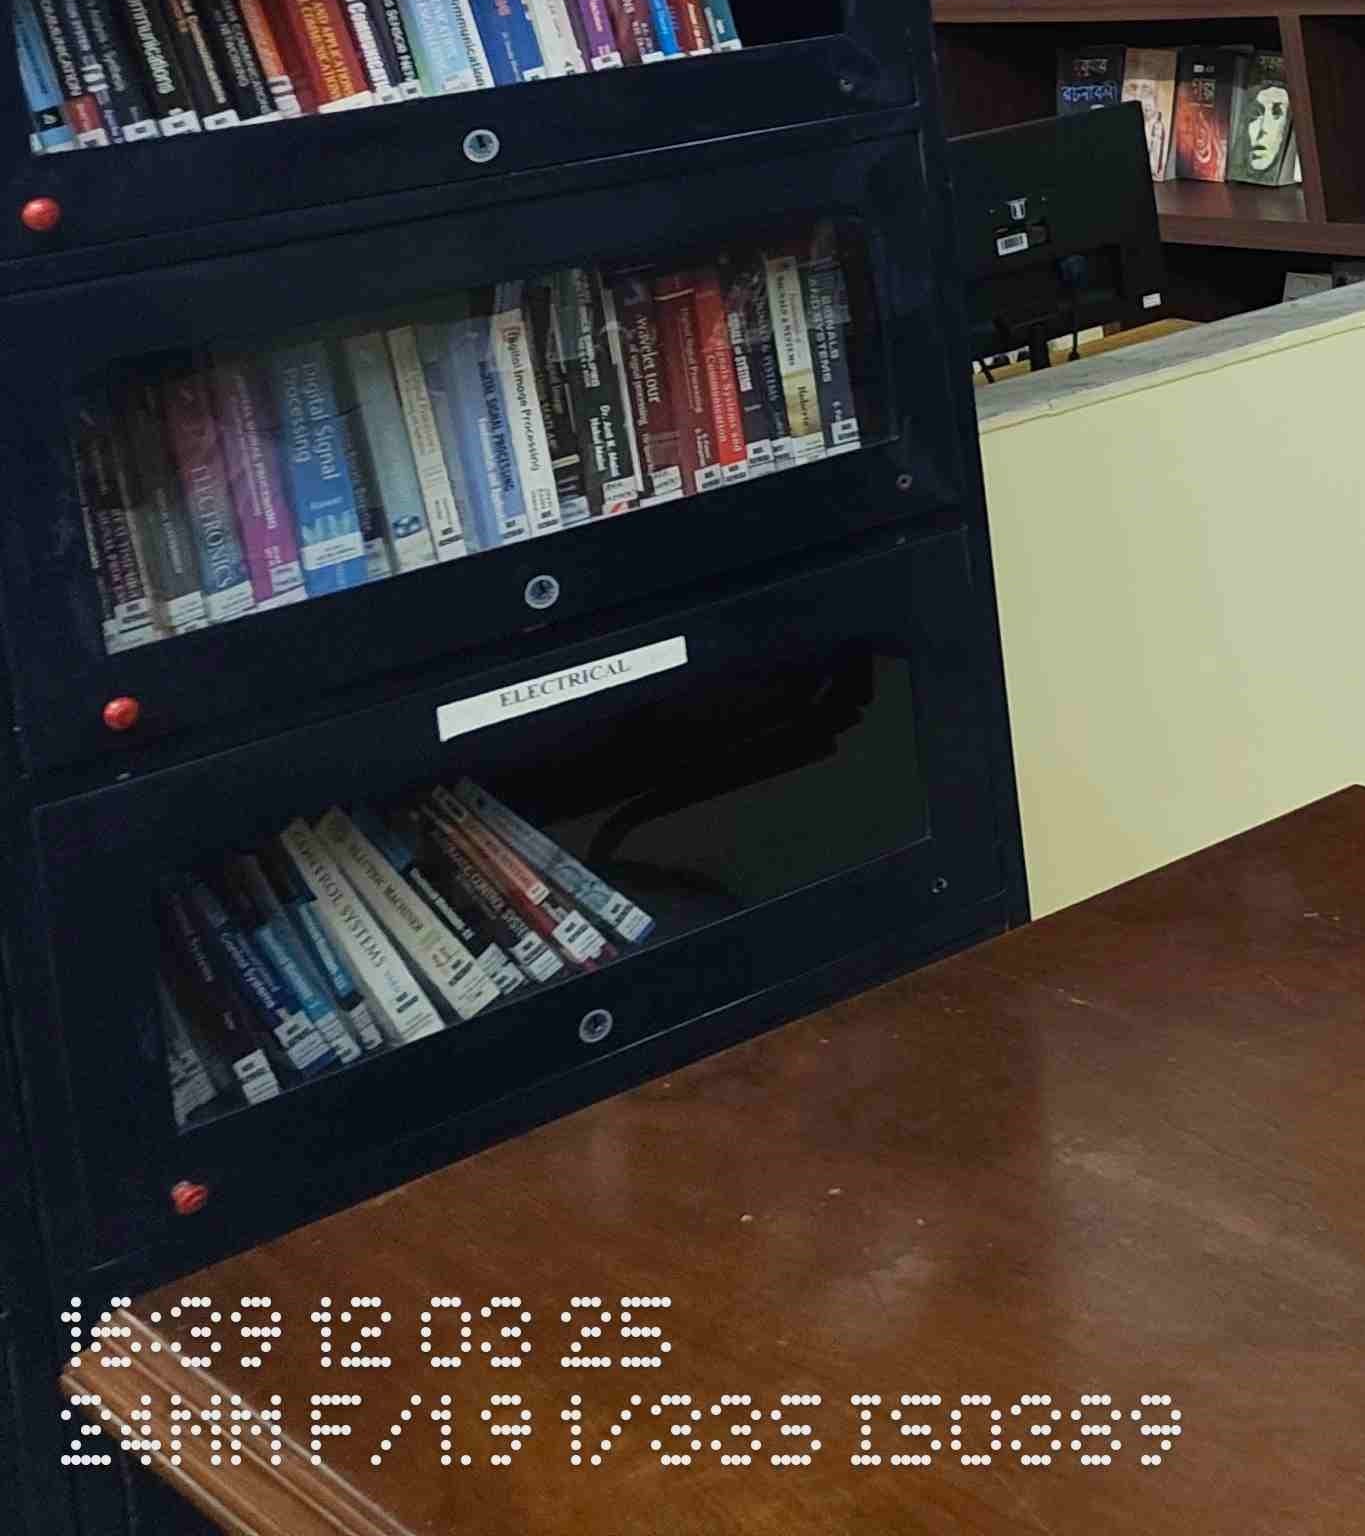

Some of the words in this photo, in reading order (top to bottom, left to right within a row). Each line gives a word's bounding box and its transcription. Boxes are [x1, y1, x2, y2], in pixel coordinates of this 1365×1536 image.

[347, 0, 391, 92] COMMUNICATI
[276, 366, 316, 465] Processing
[295, 359, 331, 422] Digital
[510, 369, 530, 407] Image
[642, 372, 664, 404] tour
[309, 423, 343, 482] Signal
[516, 408, 543, 473] Processing
[187, 463, 238, 590] ELECTRONICS
[498, 658, 632, 709] ELECTRICAL
[336, 902, 389, 970] SYSTEMS
